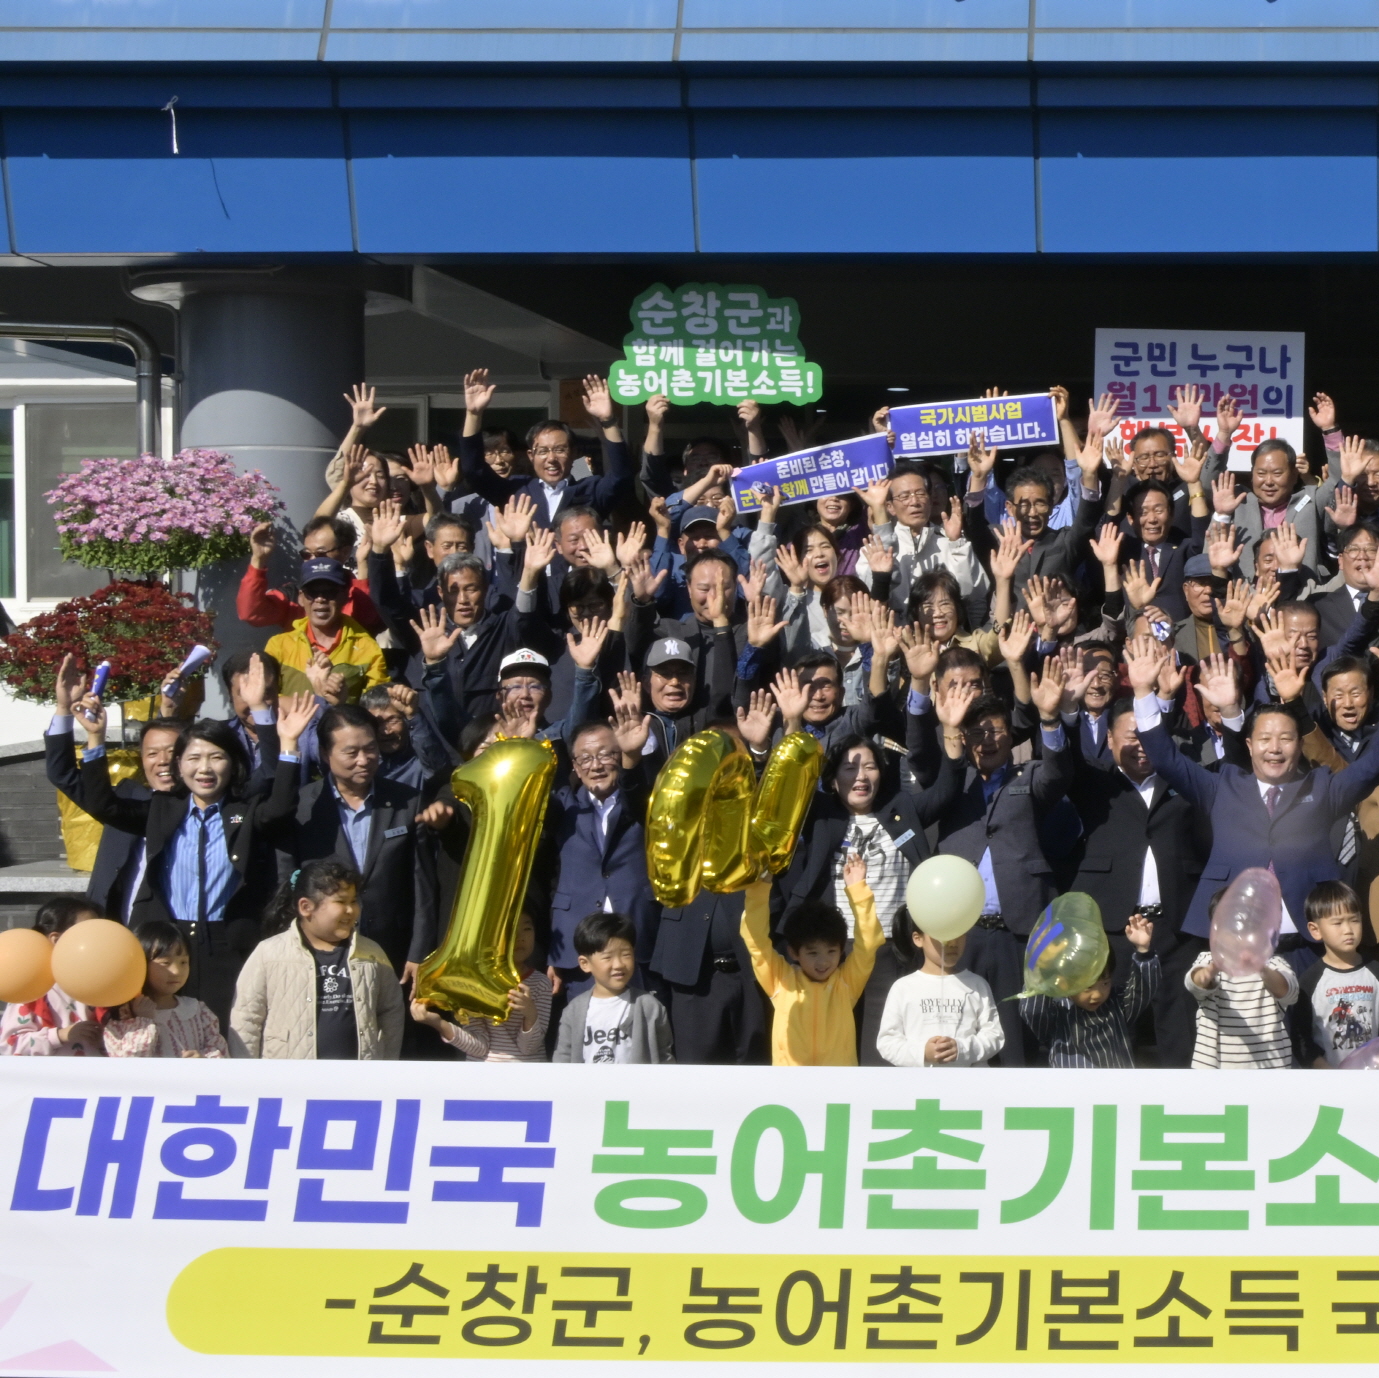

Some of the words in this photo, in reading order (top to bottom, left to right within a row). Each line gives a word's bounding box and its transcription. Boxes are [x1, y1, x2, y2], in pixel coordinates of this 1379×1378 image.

[637, 290, 793, 336] 순창군과
[632, 338, 684, 367] 함께
[691, 338, 799, 367] 걸어가는
[1110, 341, 1178, 377] 군민
[1187, 343, 1292, 379] 누구나
[616, 368, 814, 398] 농어촌기본소득!
[919, 402, 1022, 426] 국가시범사업
[900, 429, 951, 451] 열심히
[954, 421, 1047, 446] 하겠습니다.
[1203, 422, 1277, 452] 작!
[776, 457, 817, 480] 준비된
[818, 449, 851, 471] 순창,
[780, 479, 810, 498] 함께
[809, 470, 850, 494] 만들어
[11, 1095, 556, 1228] 대한민국
[682, 1265, 1304, 1352] 농어촌기본소득
